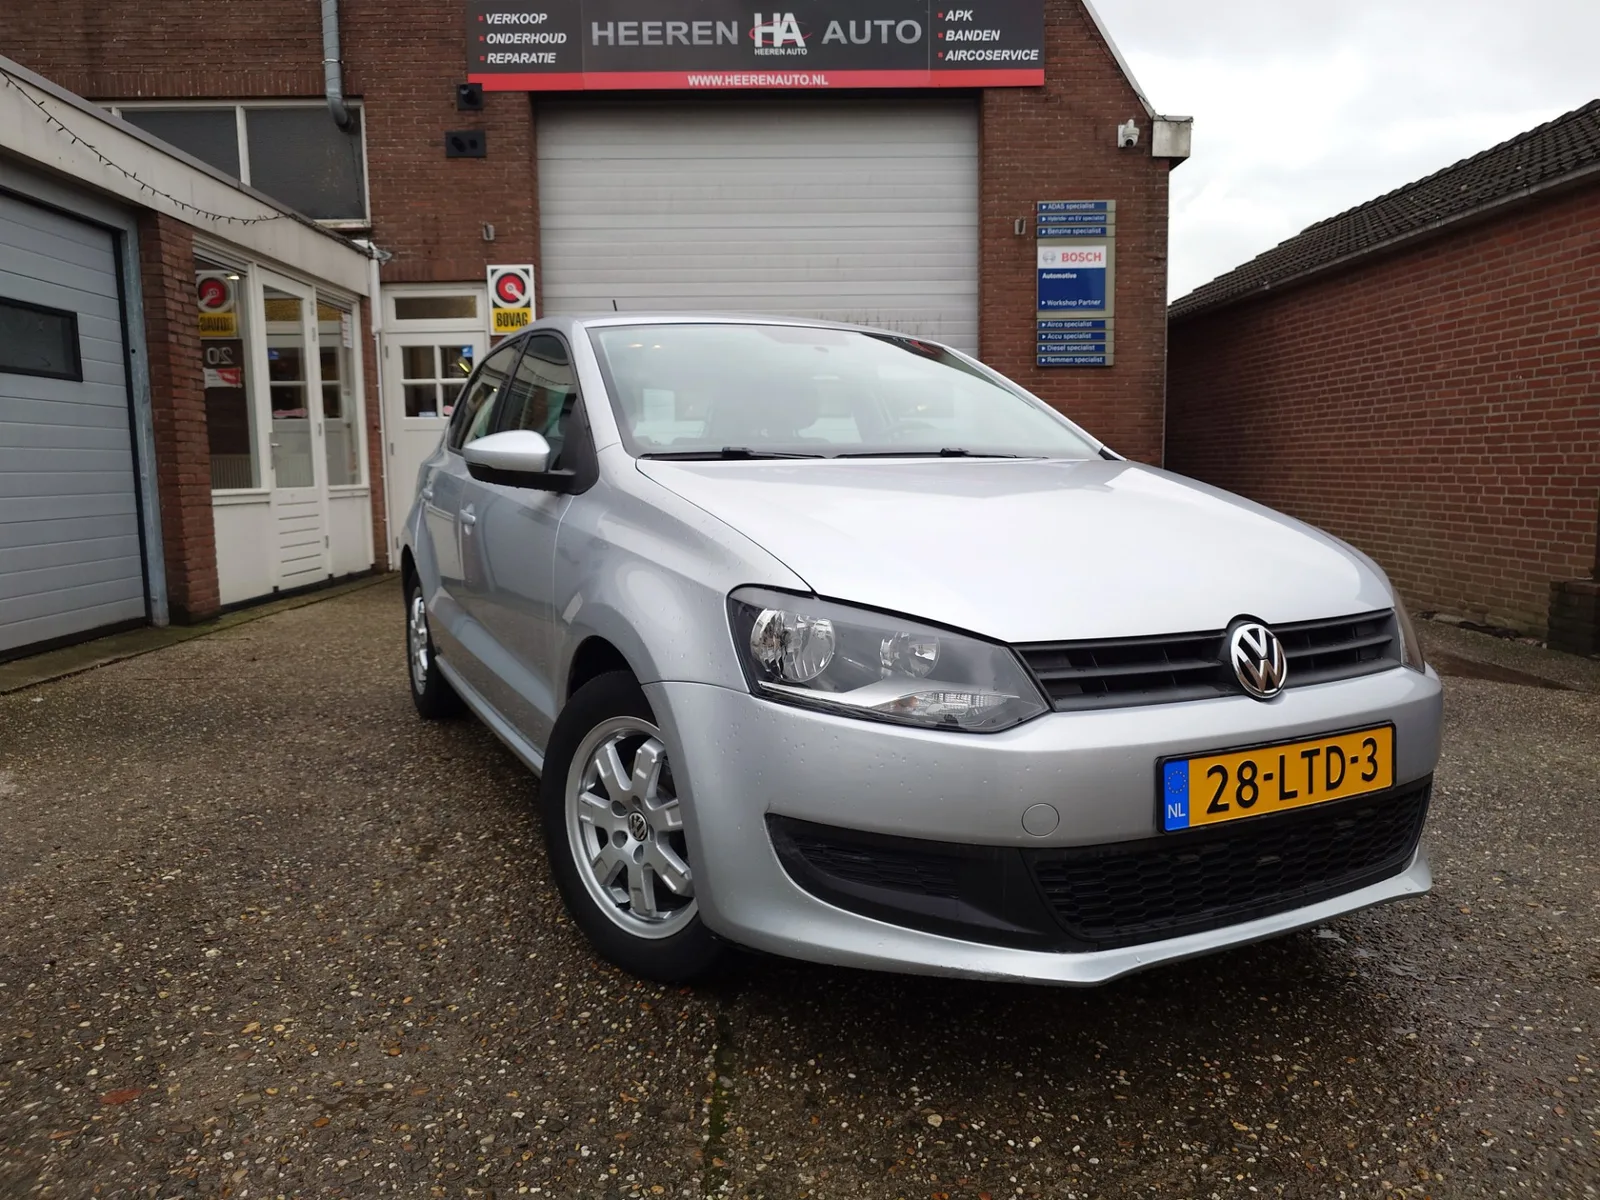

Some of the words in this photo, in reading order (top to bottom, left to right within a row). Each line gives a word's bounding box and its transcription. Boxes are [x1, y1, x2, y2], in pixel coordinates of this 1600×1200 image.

[485, 13, 548, 25] VERKOOP
[945, 10, 973, 22] APK
[486, 33, 567, 44] ONDERHOUD
[591, 21, 739, 46] HEEREN
[821, 20, 922, 45] AUTO
[945, 29, 1001, 41] BANDEN
[487, 52, 557, 64] REPARATIE
[754, 48, 785, 56] HEEREN
[945, 49, 1039, 61] AIRCOSERVICE
[687, 74, 829, 86] WWW.HEERENAUTO.NL
[1066, 202, 1095, 210] specialist
[1061, 252, 1102, 262] BOSCH
[496, 312, 528, 327] BOVAG
[1064, 321, 1093, 329] specialist
[1067, 344, 1096, 352] specialist
[1074, 356, 1103, 364] specialist
[1206, 737, 1378, 814] 28-LTD-3
[1168, 803, 1186, 819] NL
